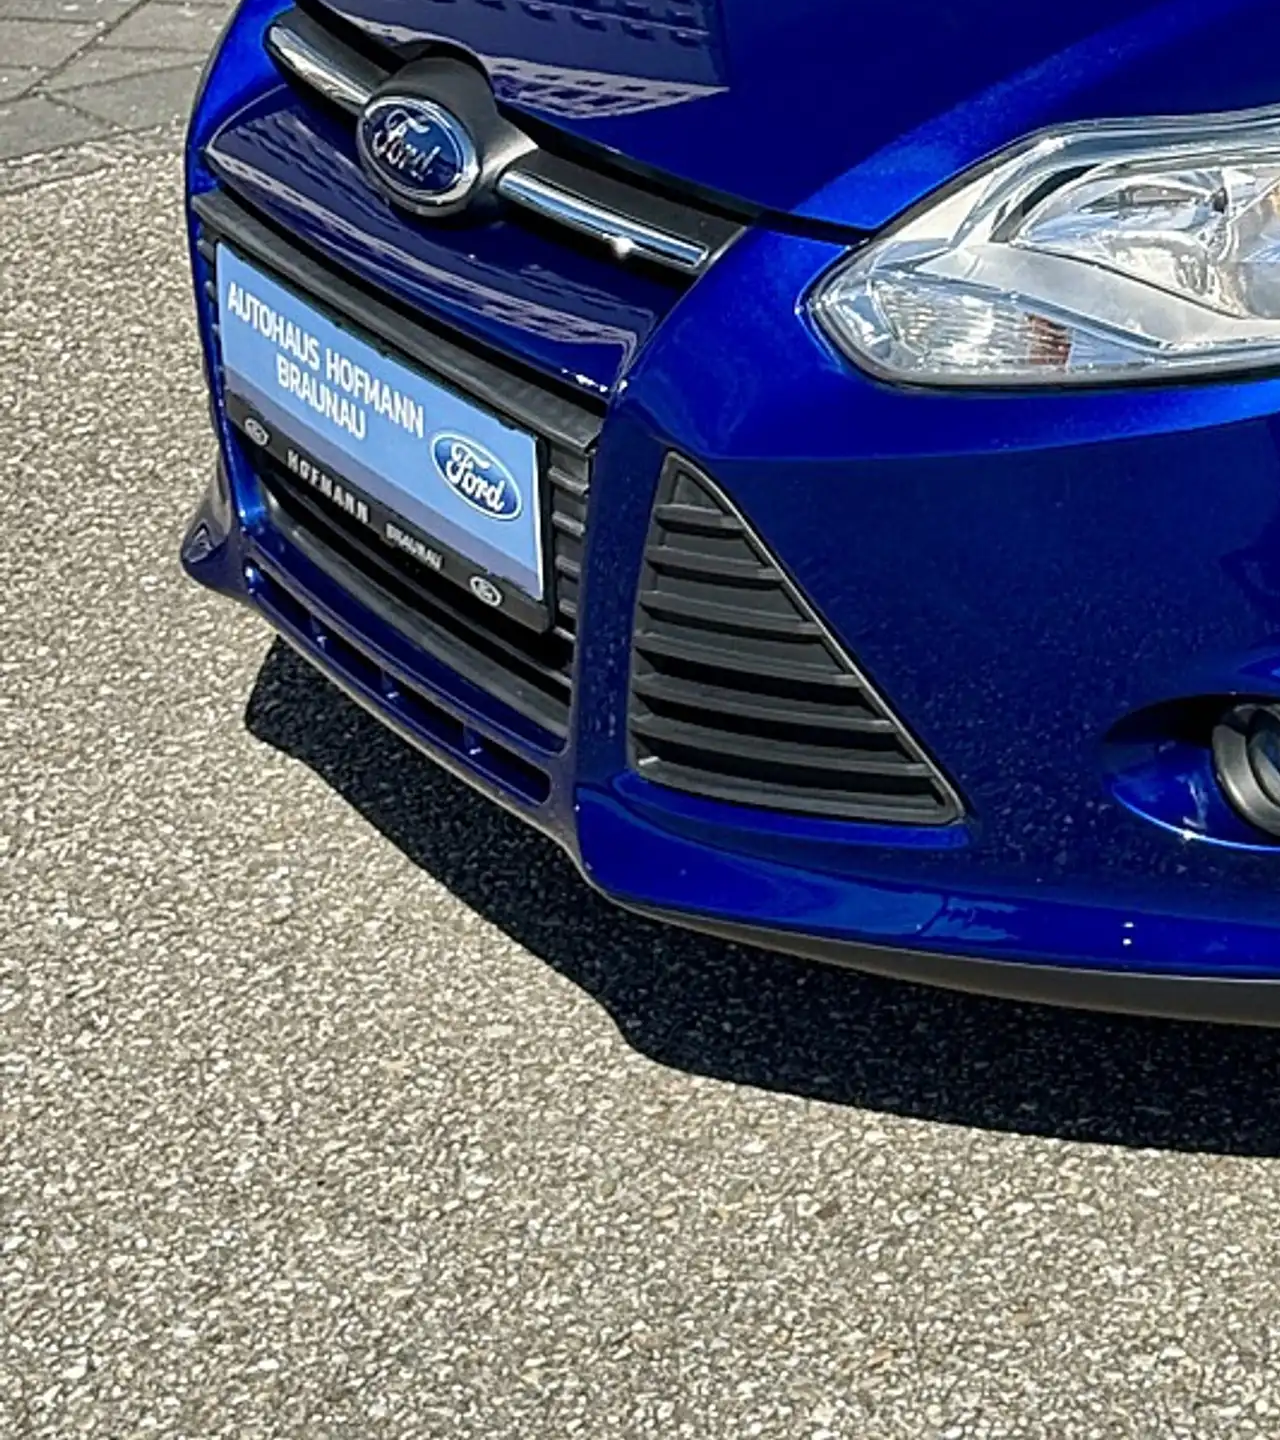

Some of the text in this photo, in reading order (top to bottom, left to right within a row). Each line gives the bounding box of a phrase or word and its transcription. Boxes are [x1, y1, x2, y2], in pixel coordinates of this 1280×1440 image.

[372, 108, 442, 182] Ford
[227, 281, 425, 439] AUTOHAUS HOFMANN
[276, 352, 367, 441] BRAUNAU
[287, 448, 370, 525] HOFMANN
[446, 441, 506, 512] Ford
